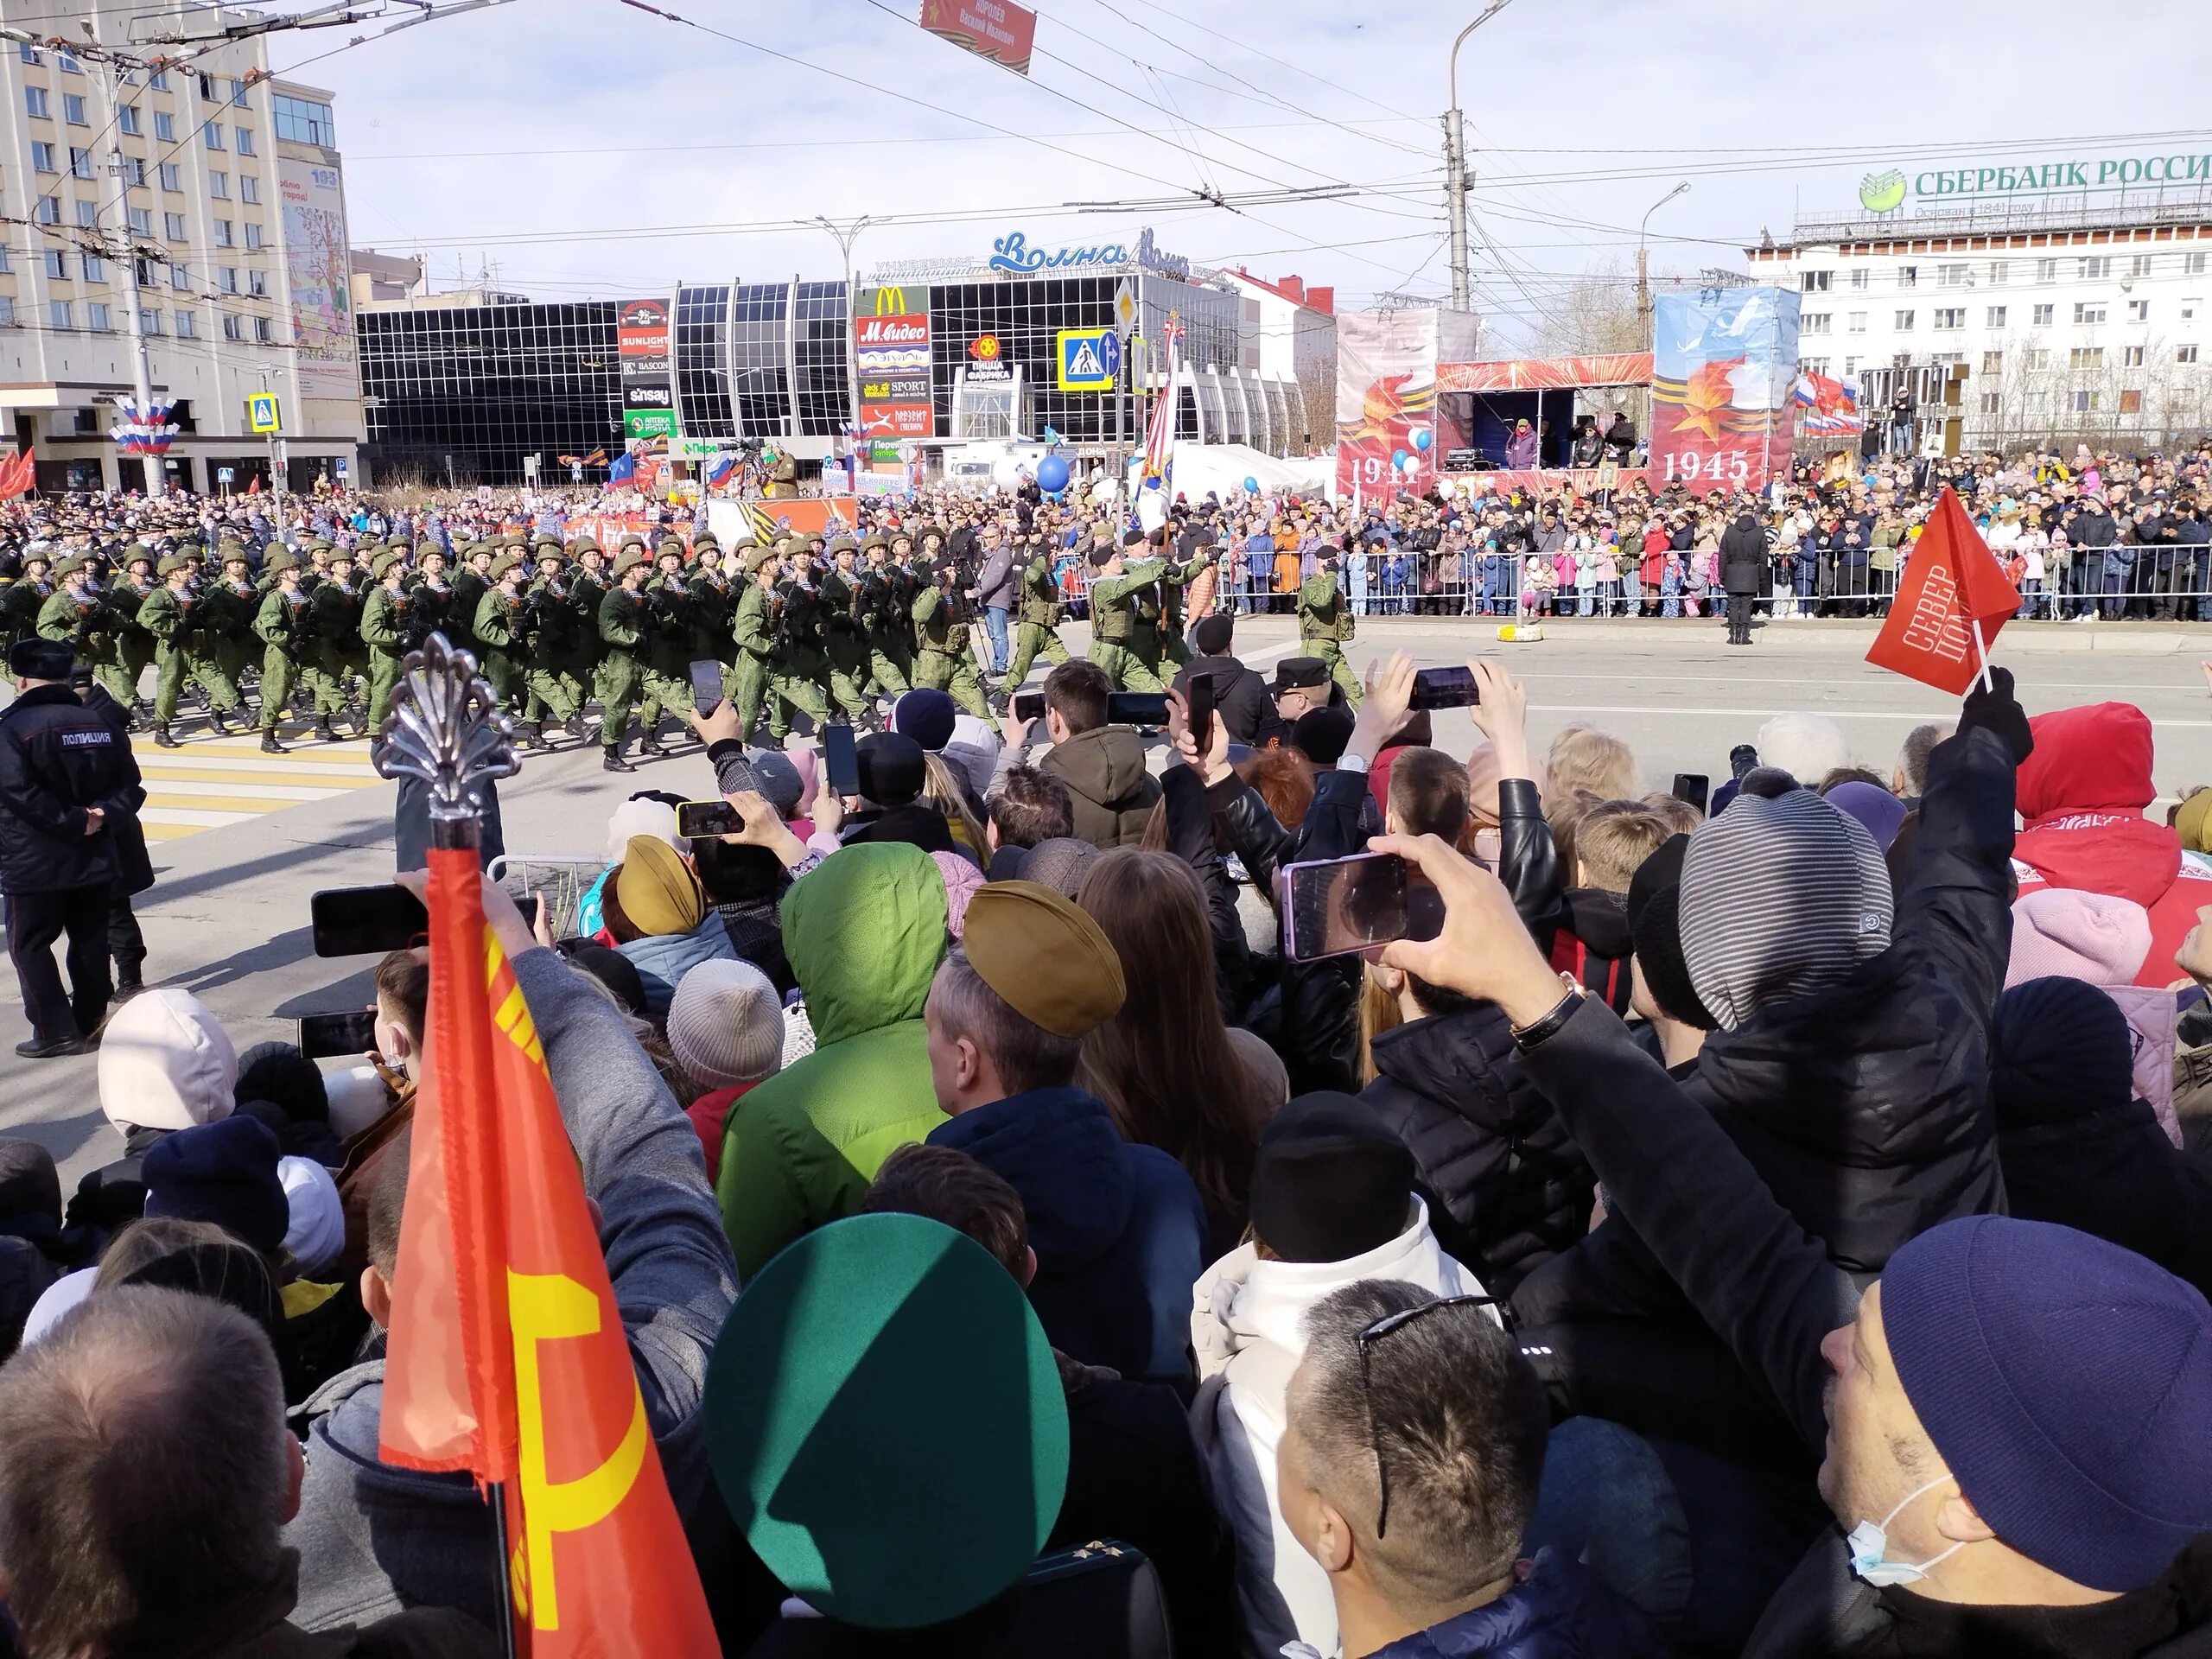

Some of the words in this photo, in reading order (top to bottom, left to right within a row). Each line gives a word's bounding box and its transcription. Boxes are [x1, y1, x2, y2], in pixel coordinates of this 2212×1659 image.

[959, 8, 987, 34] Василий
[986, 20, 1015, 48] Иванович
[1916, 162, 2088, 196] СБЕРБАНК
[2098, 154, 2212, 184] РОССИ
[1915, 207, 1967, 219] Основан
[1979, 203, 2006, 214] 1841
[988, 231, 1128, 273] Волна
[875, 256, 974, 272] УНИВЕРМАГ
[860, 321, 926, 342] М.видео
[621, 336, 669, 346] SUNLIGHT
[638, 361, 669, 370] BASCON
[971, 360, 1004, 371] ПИЦЦА
[967, 370, 1011, 380] ФАБРИКА
[891, 381, 927, 391] SPORT
[630, 387, 670, 404] sinsay
[1662, 450, 1750, 483] 1945
[1902, 564, 1957, 652] СЕВЕР
[61, 732, 111, 746] ПОЛИЦИЯ
